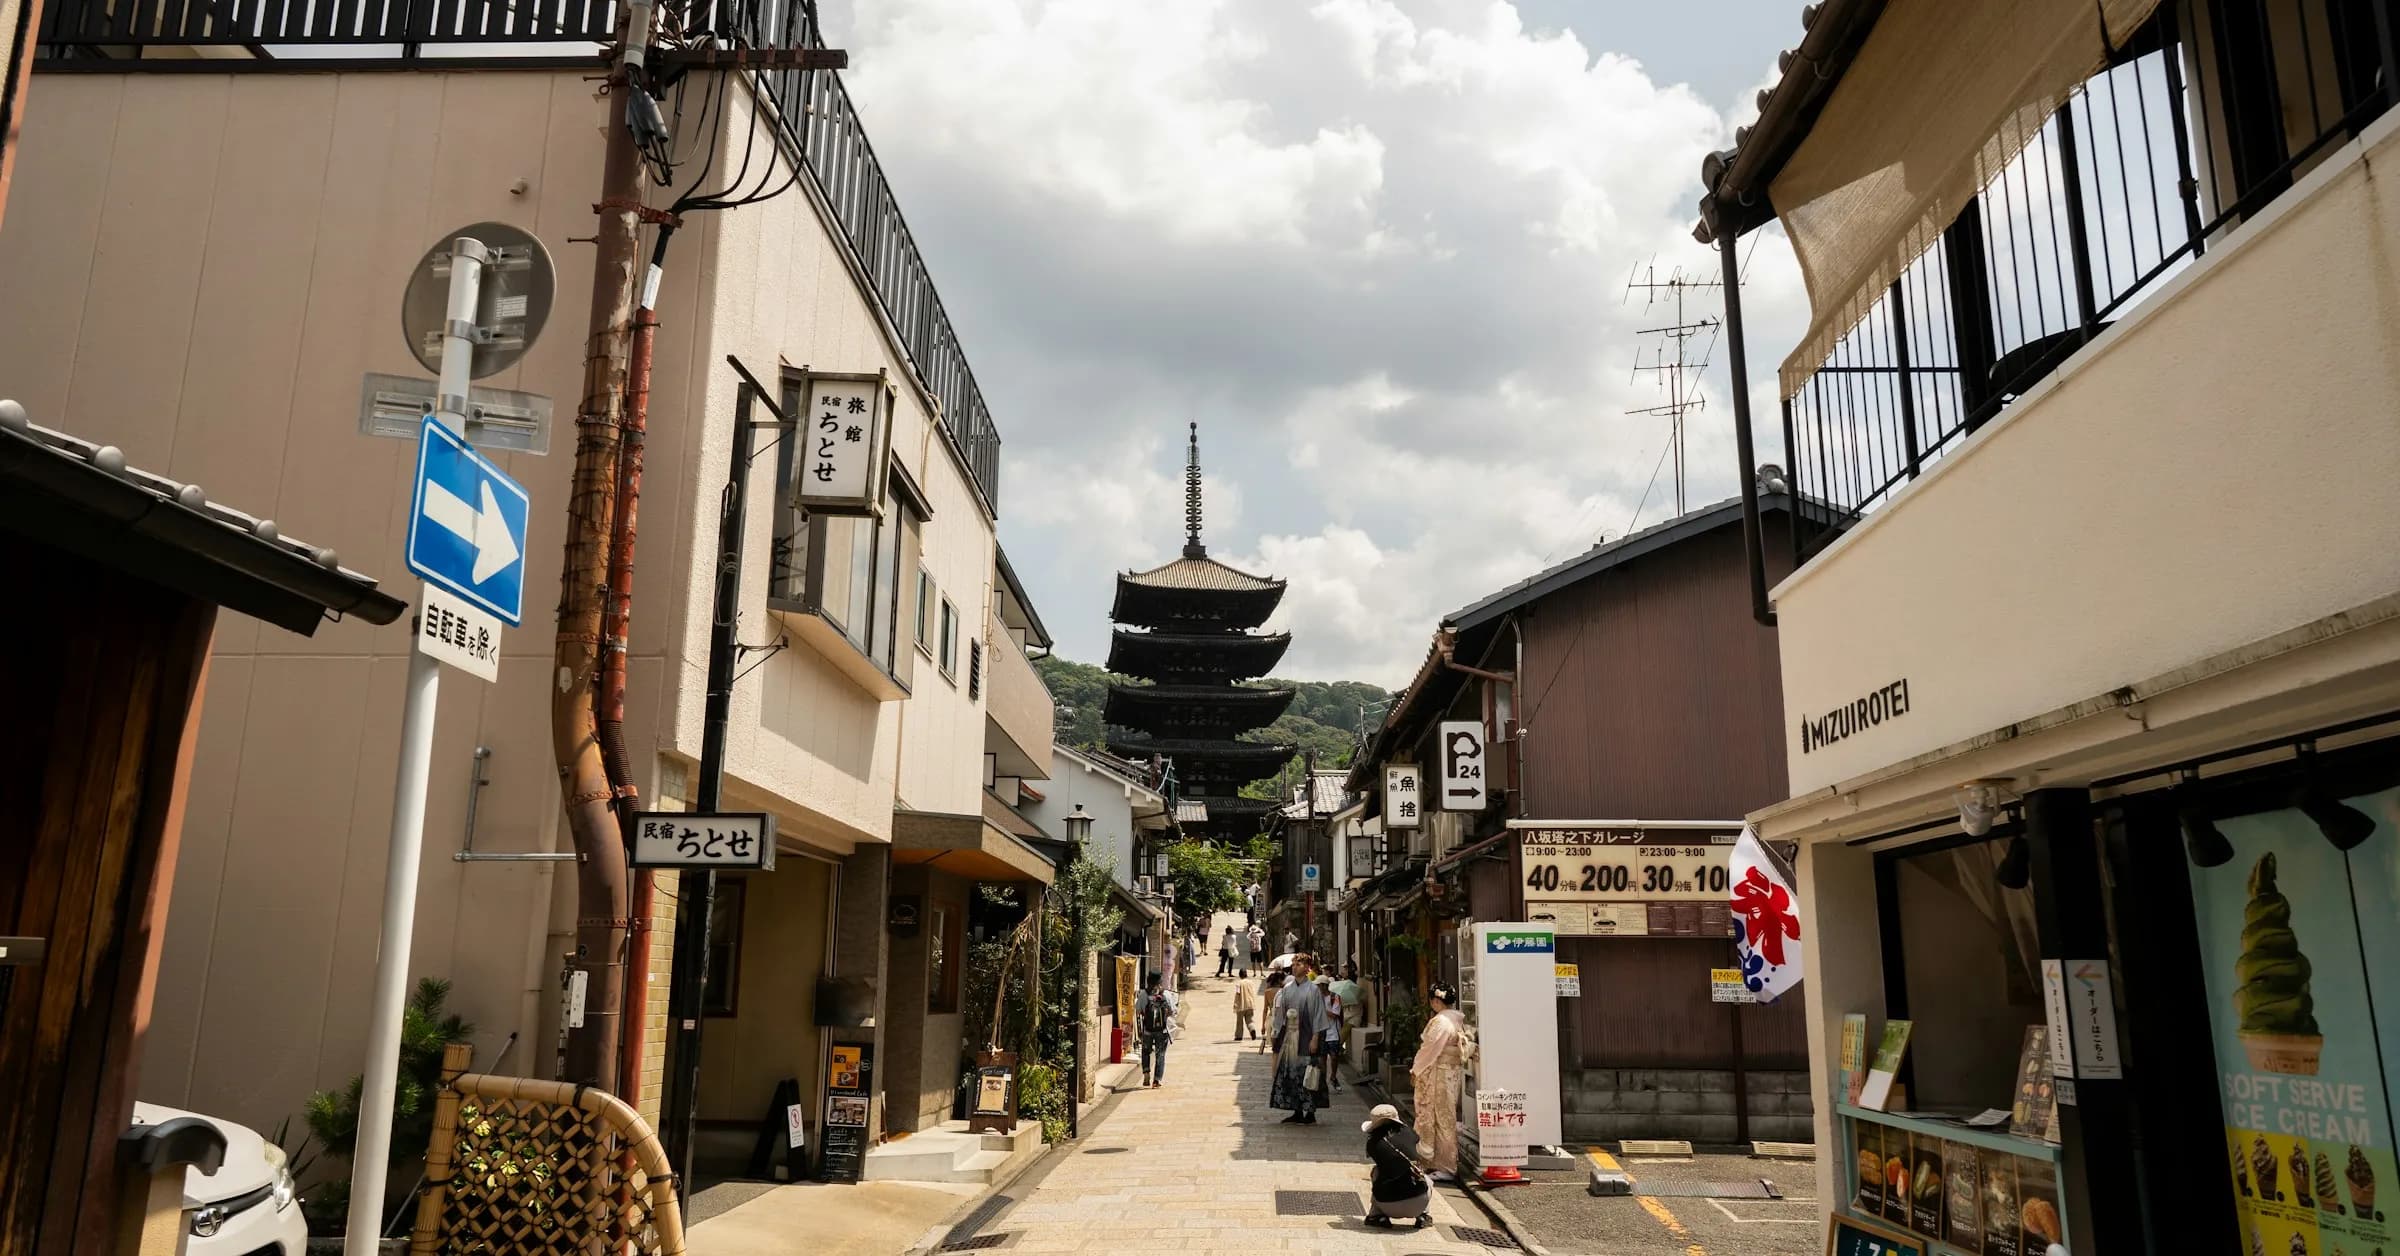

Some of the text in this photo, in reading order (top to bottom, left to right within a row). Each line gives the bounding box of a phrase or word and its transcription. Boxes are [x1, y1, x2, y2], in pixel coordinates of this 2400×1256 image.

[821, 396, 842, 407] 民宿
[843, 397, 867, 442] 旅館
[812, 412, 839, 482] ちとせ
[426, 602, 496, 665] 自転車を除く
[1811, 678, 1910, 751] MIZUIROTEI
[1460, 765, 1480, 779] 24
[1400, 776, 1416, 817] 魚捨
[643, 822, 675, 840] 民宿
[677, 827, 754, 858] ちとせ
[1525, 831, 1645, 844] 八坂塔之下ガレージ
[1694, 865, 1730, 892] 10
[1730, 865, 1800, 966] 氷
[1512, 936, 1547, 948] 伊藤園
[2225, 1073, 2367, 1112] SOFT SERVE
[1479, 1112, 1527, 1127] 禁止です
[2228, 1102, 2371, 1146] ICE CREAM
